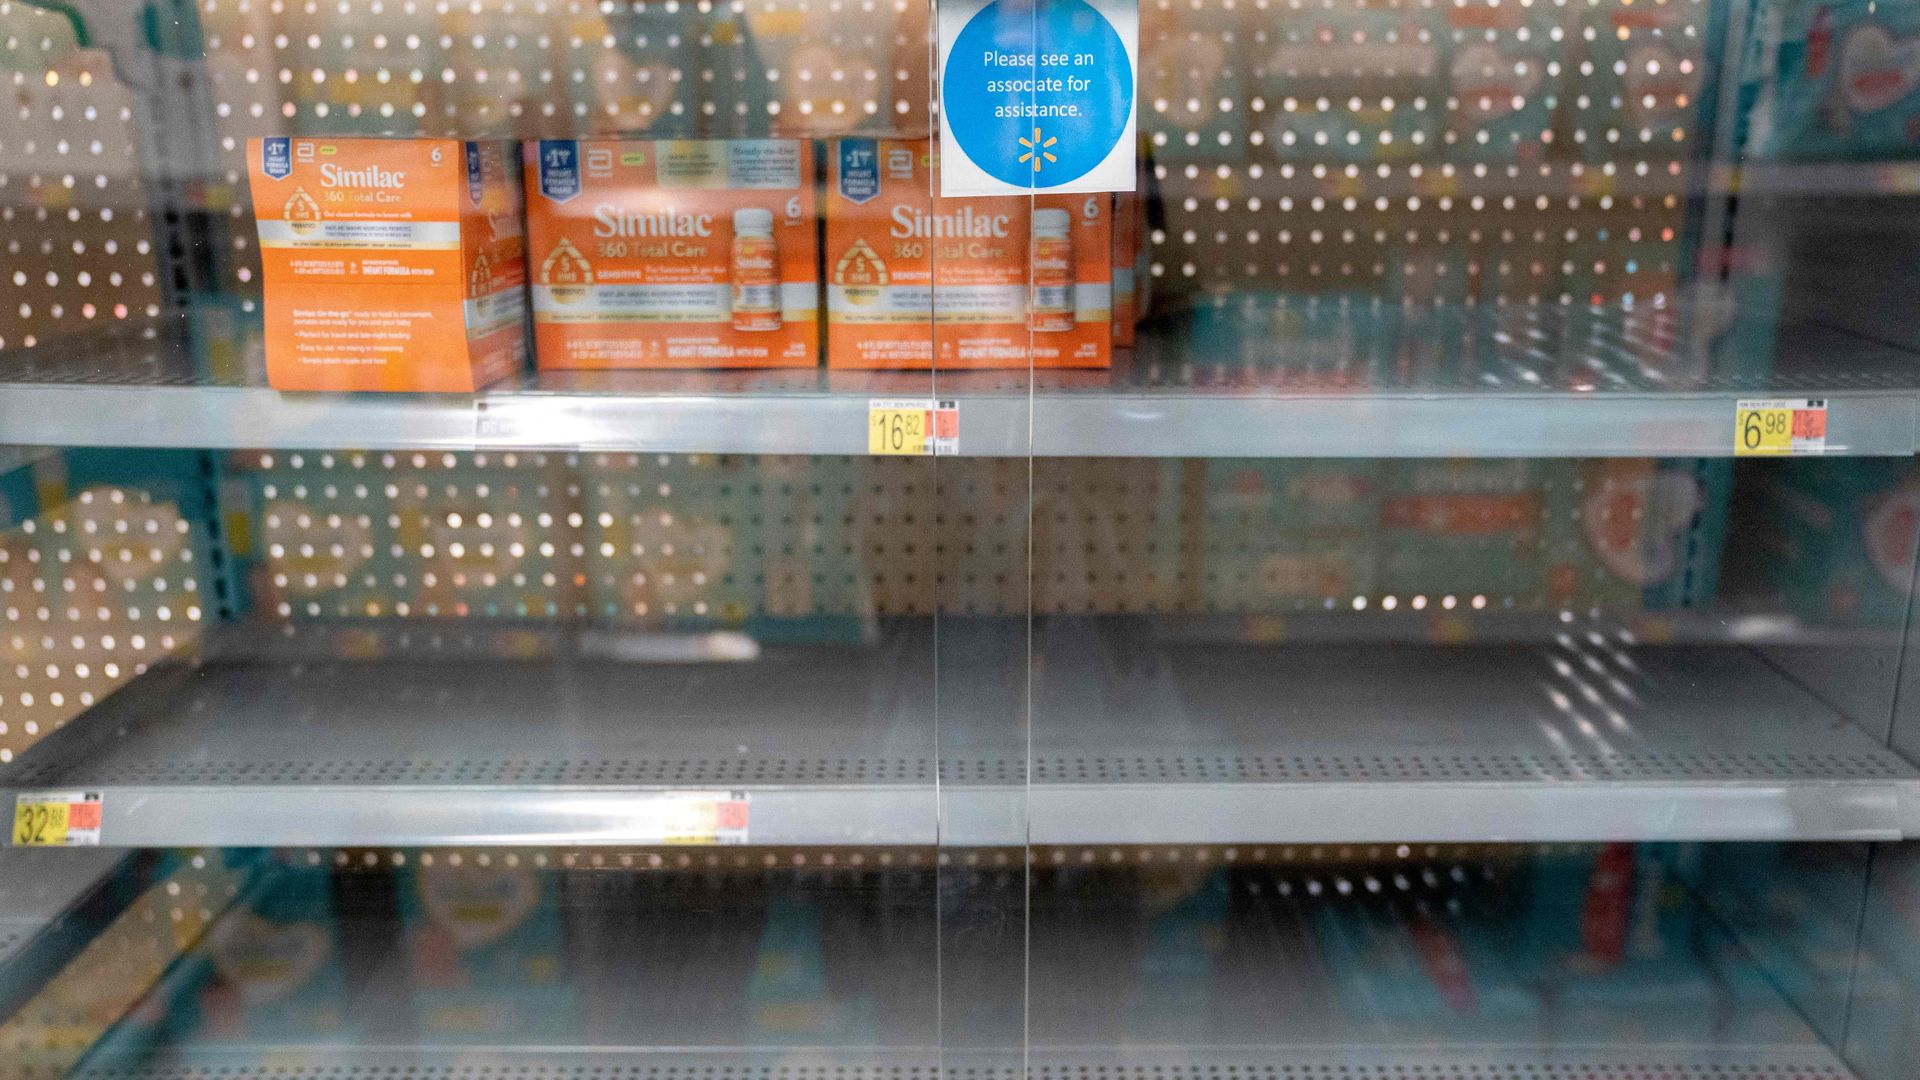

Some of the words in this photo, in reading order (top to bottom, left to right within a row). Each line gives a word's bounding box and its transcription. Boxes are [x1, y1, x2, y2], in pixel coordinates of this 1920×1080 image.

[984, 51, 1035, 66] Please
[1041, 53, 1069, 66] see
[1074, 53, 1094, 66] an
[987, 79, 1062, 92] assocate
[1067, 75, 1091, 91] for
[995, 102, 1082, 117] assistance.
[432, 147, 442, 161] 6
[320, 163, 405, 188] Similac
[324, 190, 344, 202] 360
[376, 190, 401, 202] Care
[785, 196, 801, 218] 6
[1083, 196, 1098, 218] 6
[593, 204, 713, 238] Similac
[890, 204, 1009, 239] Similac
